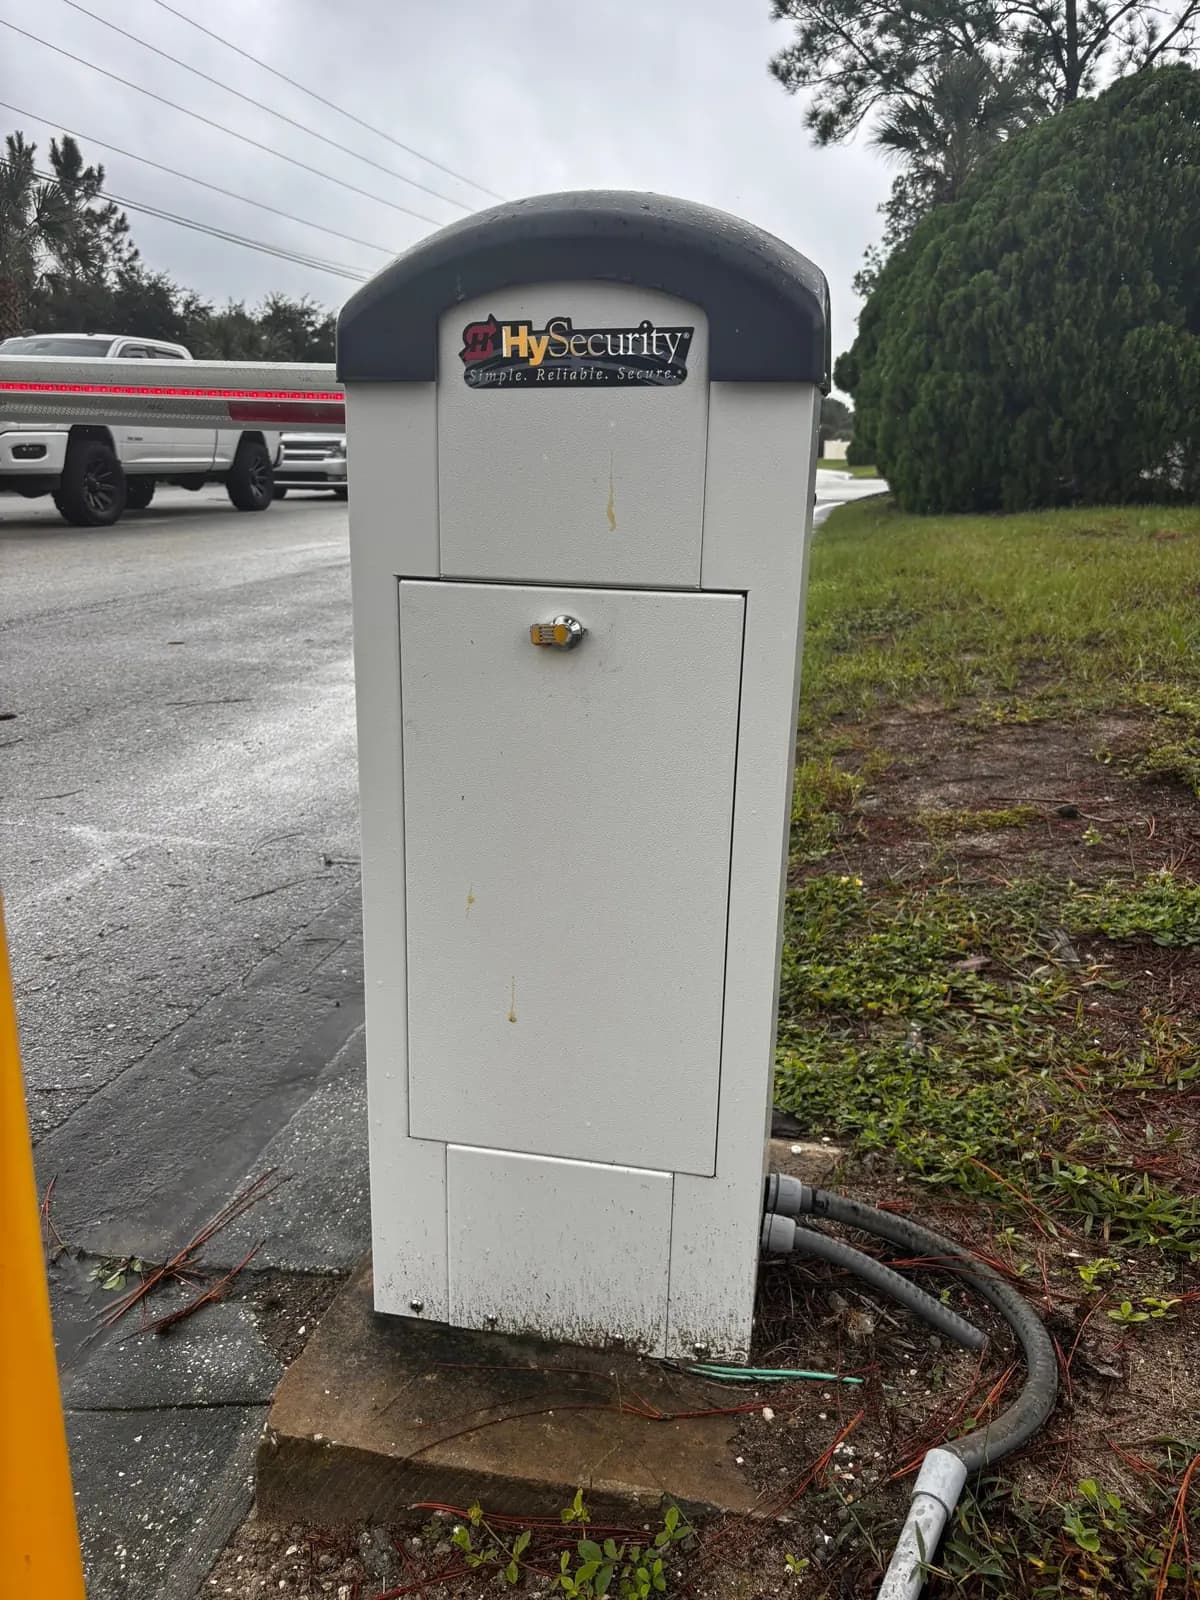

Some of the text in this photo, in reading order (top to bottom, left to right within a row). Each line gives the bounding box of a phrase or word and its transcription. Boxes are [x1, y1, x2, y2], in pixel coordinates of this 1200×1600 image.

[468, 367, 677, 384] Simple. Reliable. Secure.
